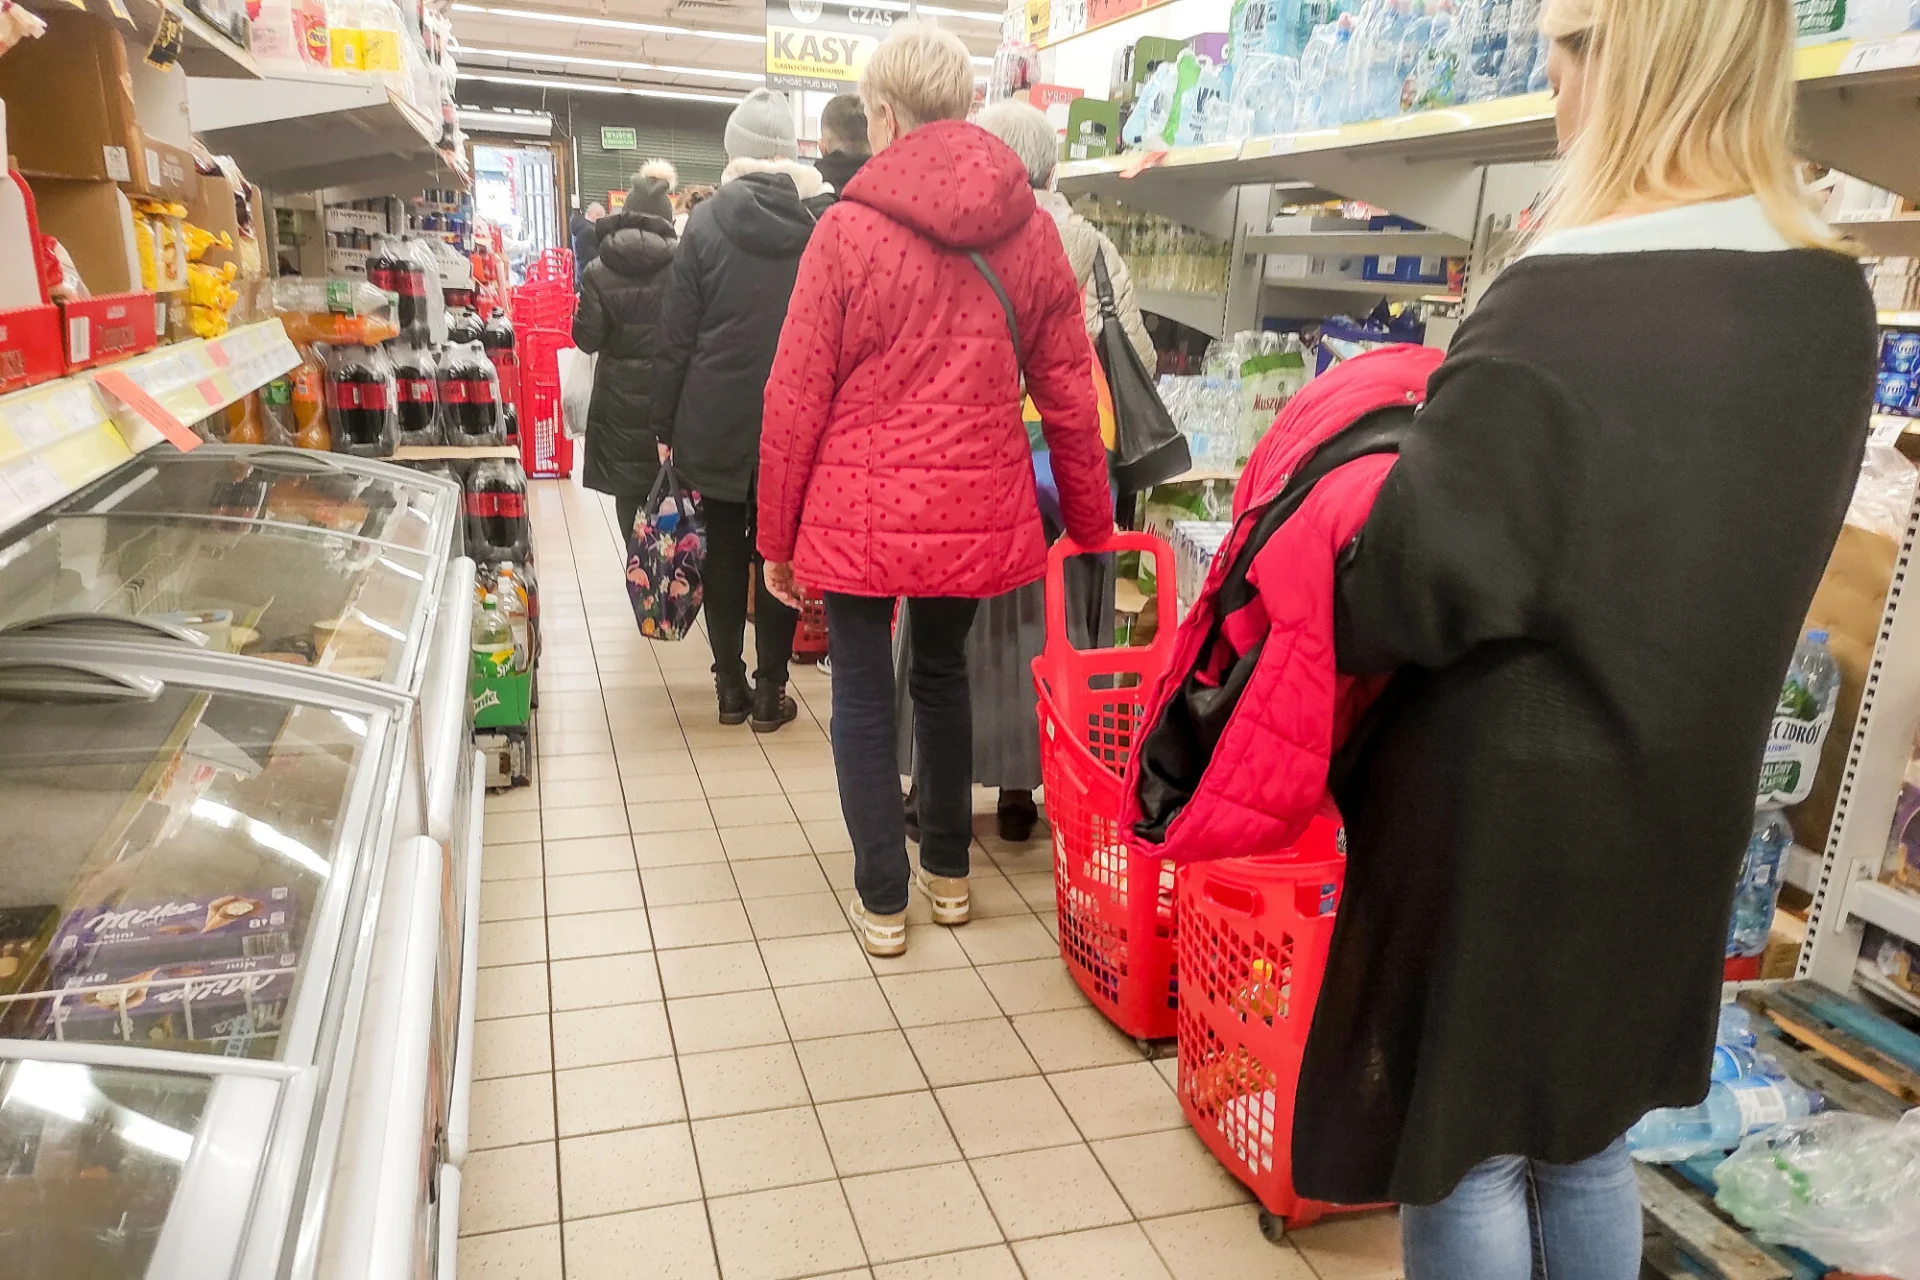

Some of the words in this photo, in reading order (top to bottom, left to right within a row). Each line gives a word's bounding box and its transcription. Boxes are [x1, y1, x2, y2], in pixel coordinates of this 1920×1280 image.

[848, 6, 893, 28] CZAS
[774, 31, 859, 66] KASY
[1782, 721, 1823, 745] ZDRÓJ
[84, 902, 202, 933] Milka
[152, 974, 276, 1003] Milka
